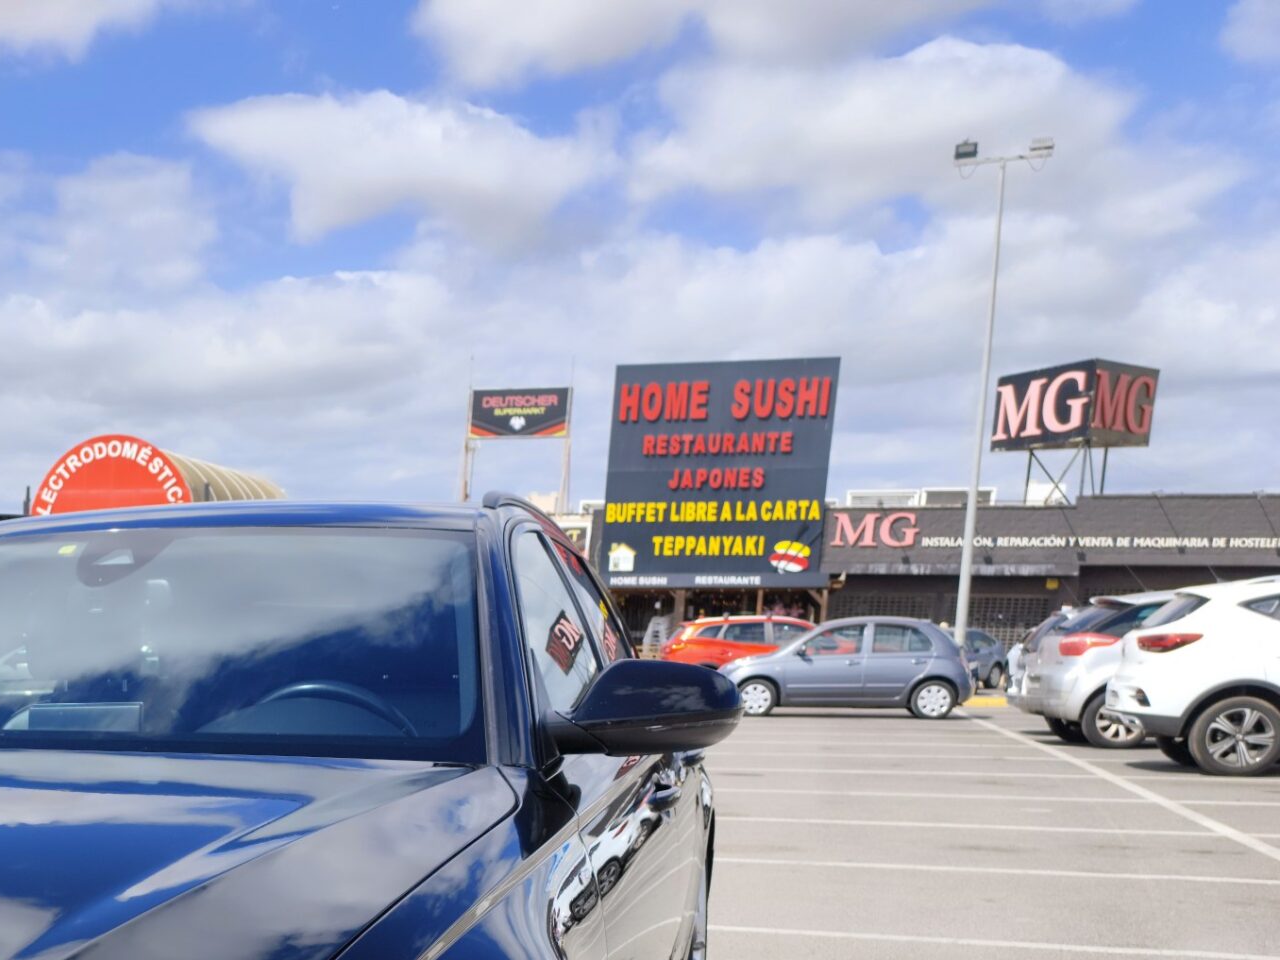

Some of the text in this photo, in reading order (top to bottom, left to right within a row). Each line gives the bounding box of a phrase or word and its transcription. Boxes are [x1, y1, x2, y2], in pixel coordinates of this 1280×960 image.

[482, 395, 558, 408] DEUTSCHER
[619, 376, 832, 422] HOME SUSHI
[992, 370, 1090, 441] MG
[1091, 369, 1155, 435] MG
[642, 432, 794, 456] RESTAURANTE
[35, 439, 184, 516] LECTRODOMÉSTIC
[667, 467, 765, 490] JAPONES
[605, 499, 821, 523] BUFFET LIBRE A LA CARTA
[830, 511, 920, 548] MG
[921, 534, 1280, 548] INSTALAÓN, REPARACIÓN Y VENTA DE MAQUINARIA DE HOSTELE
[652, 536, 766, 556] TEPPANYAKI
[610, 575, 761, 585] HOME SUSHI RESTAURANTE
